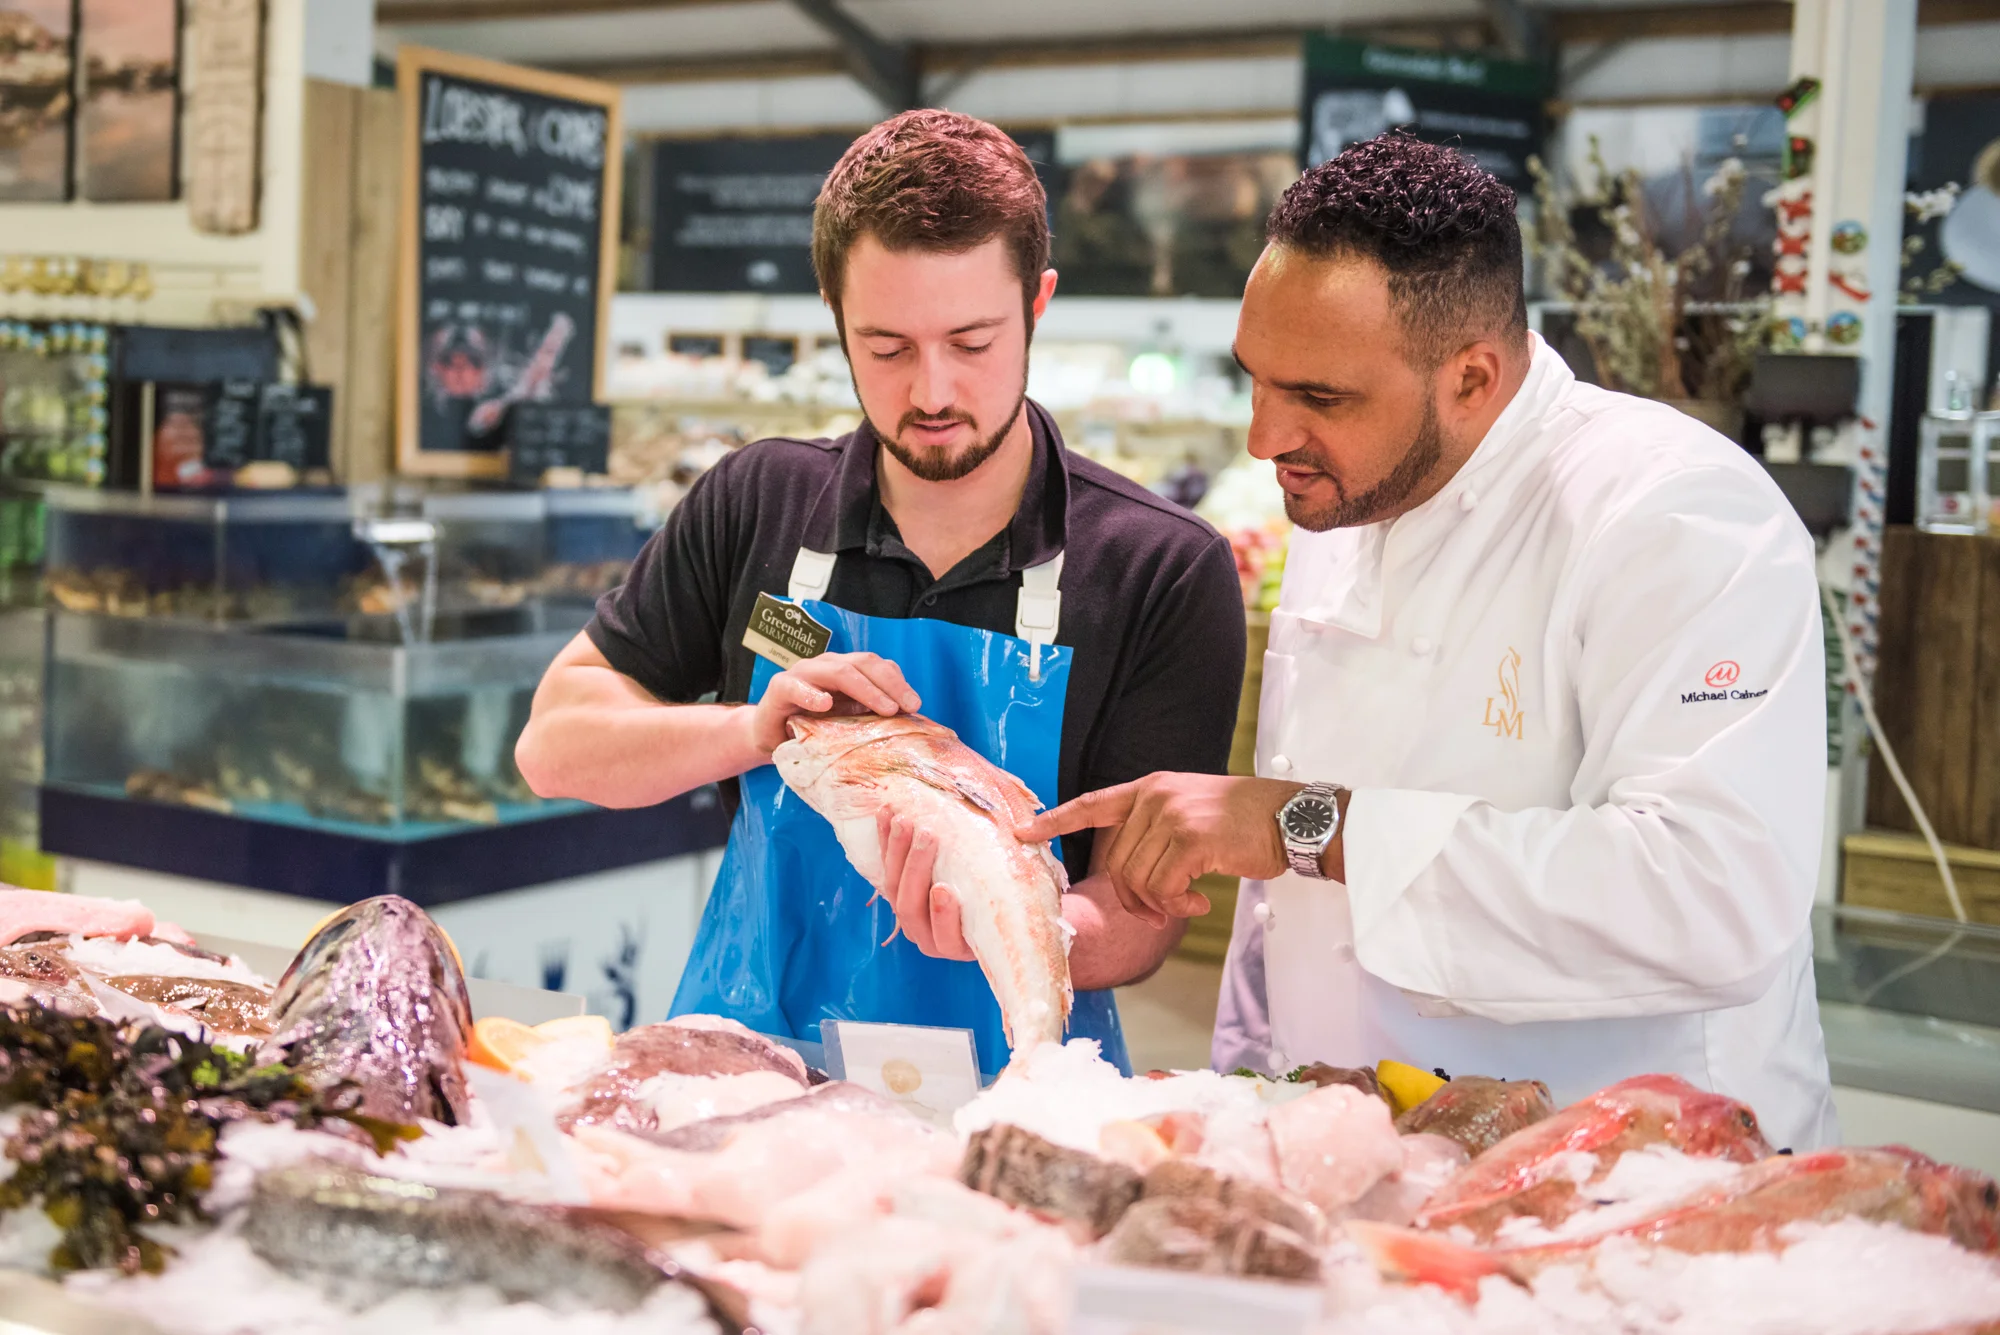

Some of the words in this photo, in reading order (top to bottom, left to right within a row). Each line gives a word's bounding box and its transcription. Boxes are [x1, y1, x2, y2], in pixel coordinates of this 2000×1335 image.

[757, 621, 785, 642] FARM
[786, 634, 813, 657] SHOP
[762, 608, 817, 648] Greendale
[1681, 690, 1727, 704] Michael
